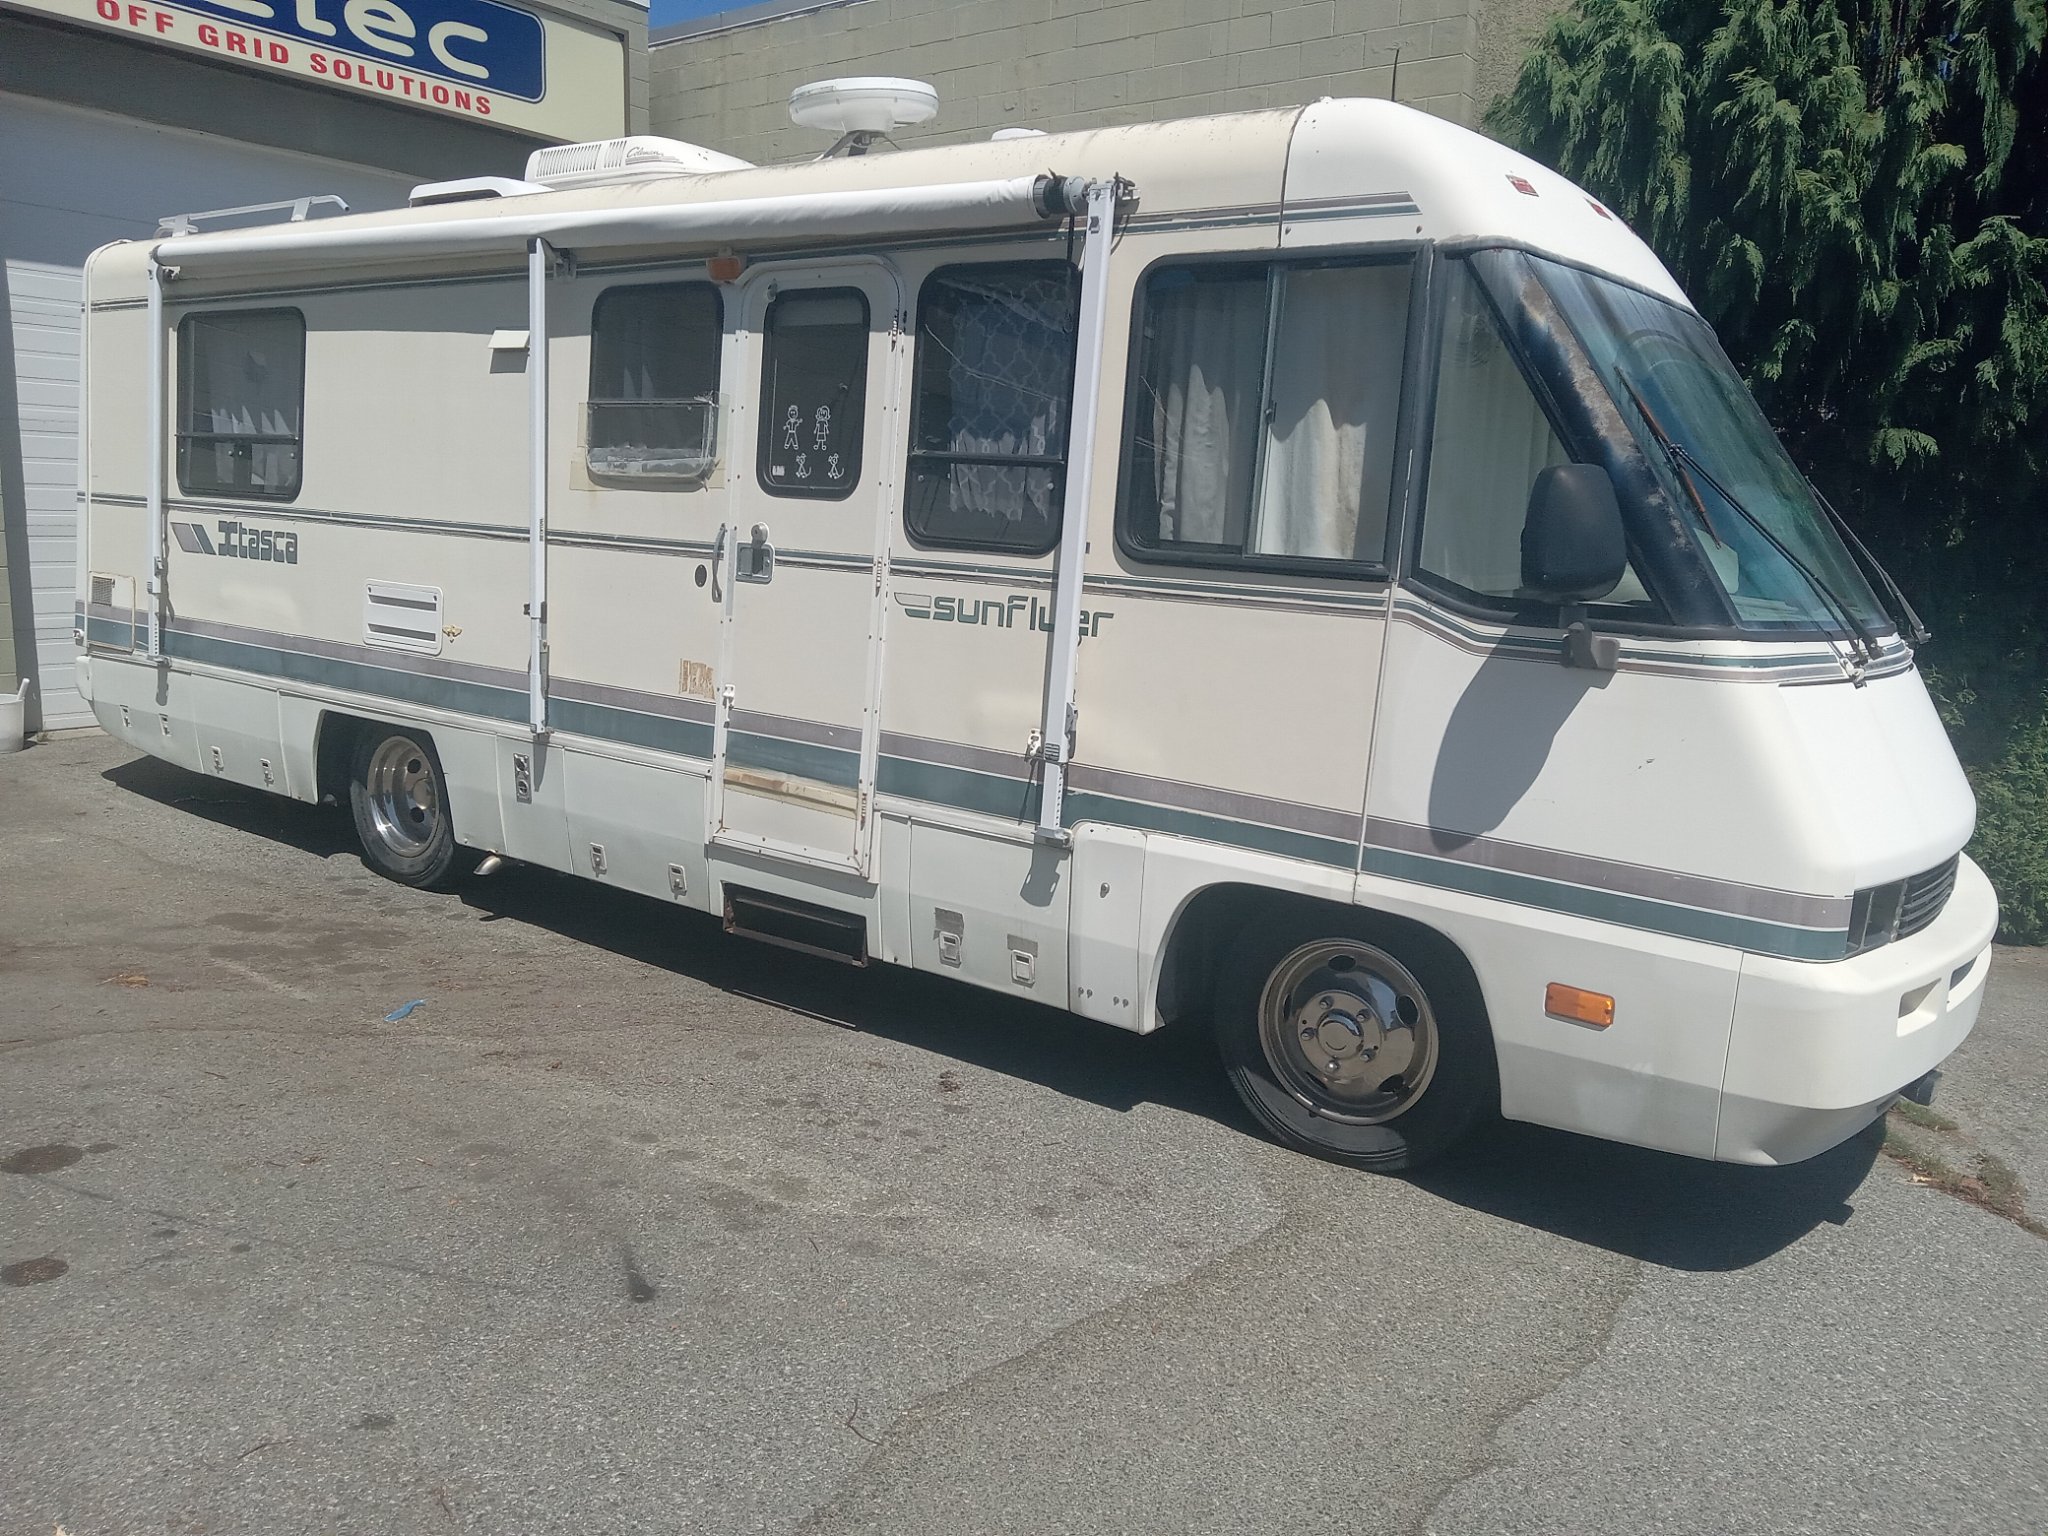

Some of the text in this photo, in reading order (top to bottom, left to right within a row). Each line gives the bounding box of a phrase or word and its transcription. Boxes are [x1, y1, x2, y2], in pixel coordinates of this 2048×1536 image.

[97, 0, 492, 115] OFF GRID SOLUTIONS
[218, 521, 298, 564] Itasca
